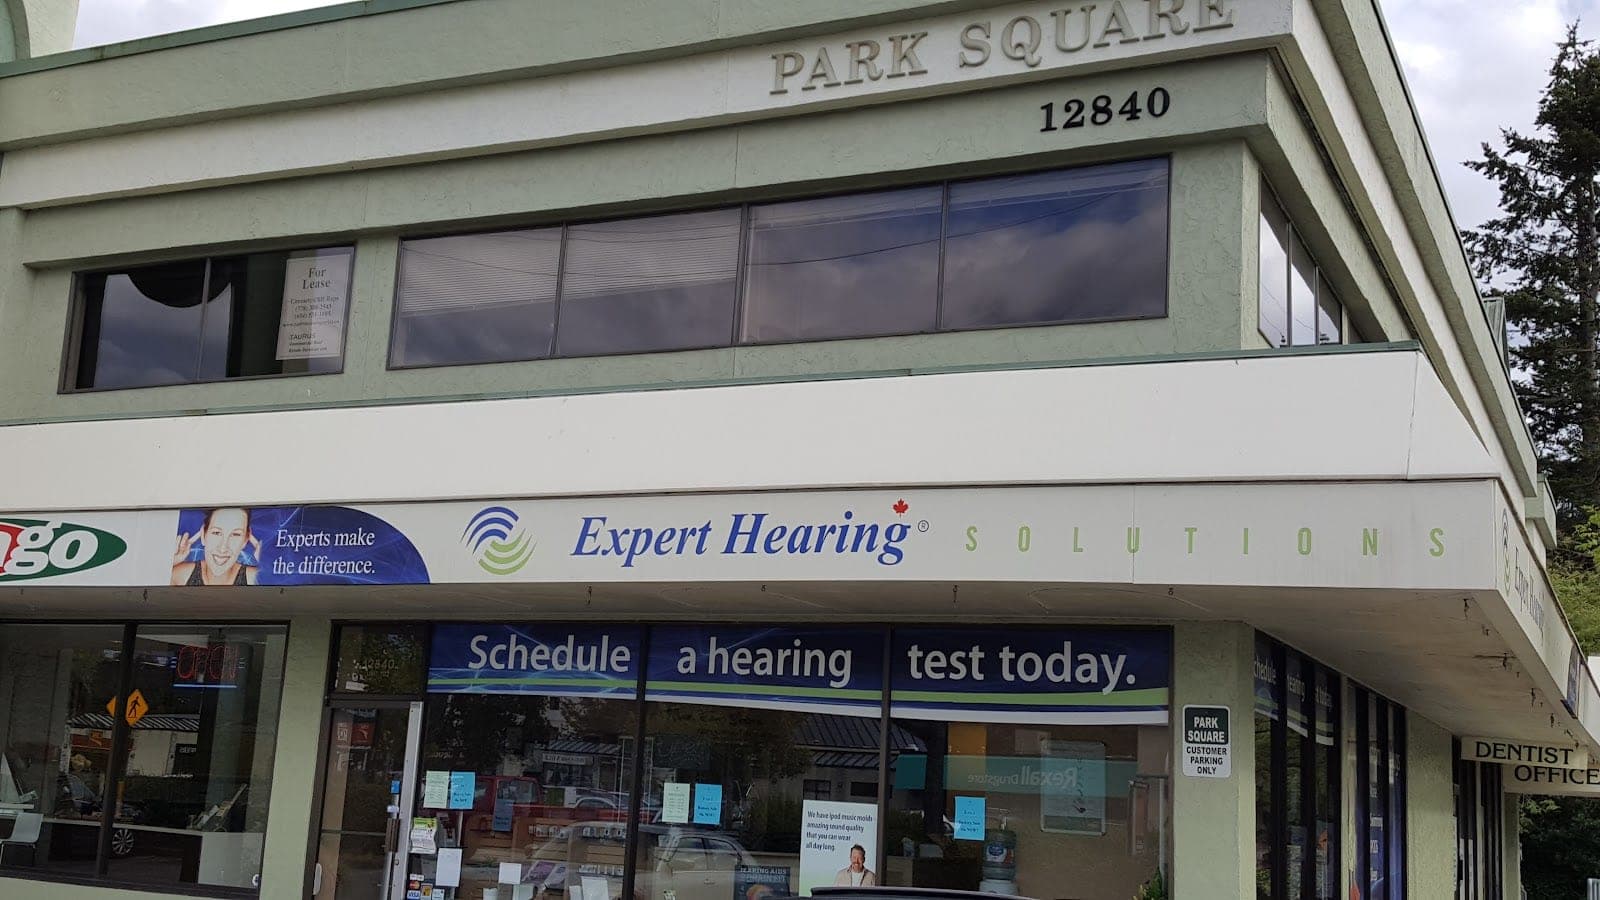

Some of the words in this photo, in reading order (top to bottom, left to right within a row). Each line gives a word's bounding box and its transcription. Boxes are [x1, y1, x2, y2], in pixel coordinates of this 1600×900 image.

[769, 31, 929, 96] PARK
[958, 0, 1234, 68] SQUARE
[1039, 86, 1171, 133] 12840
[308, 267, 327, 279] For
[302, 279, 331, 290] Lease
[275, 528, 331, 549] Experts
[333, 529, 376, 547] make
[569, 516, 713, 568] Expert
[720, 509, 912, 567] Hearing
[964, 525, 1445, 558] SOLUTIONS
[272, 557, 296, 575] the
[297, 557, 376, 576] difference.
[467, 633, 632, 674] Schedule
[676, 646, 697, 675] a
[707, 635, 853, 690] hearing
[906, 644, 986, 681] test
[998, 640, 1137, 696] today.
[1193, 716, 1219, 729] PARK
[1187, 729, 1225, 743] SQUARE
[1186, 746, 1228, 756] CUSTOMER
[1475, 741, 1574, 765] DENTIST
[1190, 756, 1224, 766] PARKING
[1196, 766, 1217, 775] ONLY
[1514, 764, 1600, 785] OFFICE
[816, 811, 829, 819] have
[806, 822, 829, 831] amazing
[829, 822, 845, 830] sound
[845, 824, 864, 833] quality
[806, 831, 817, 839] that
[817, 833, 828, 841] you
[812, 842, 822, 851] day
